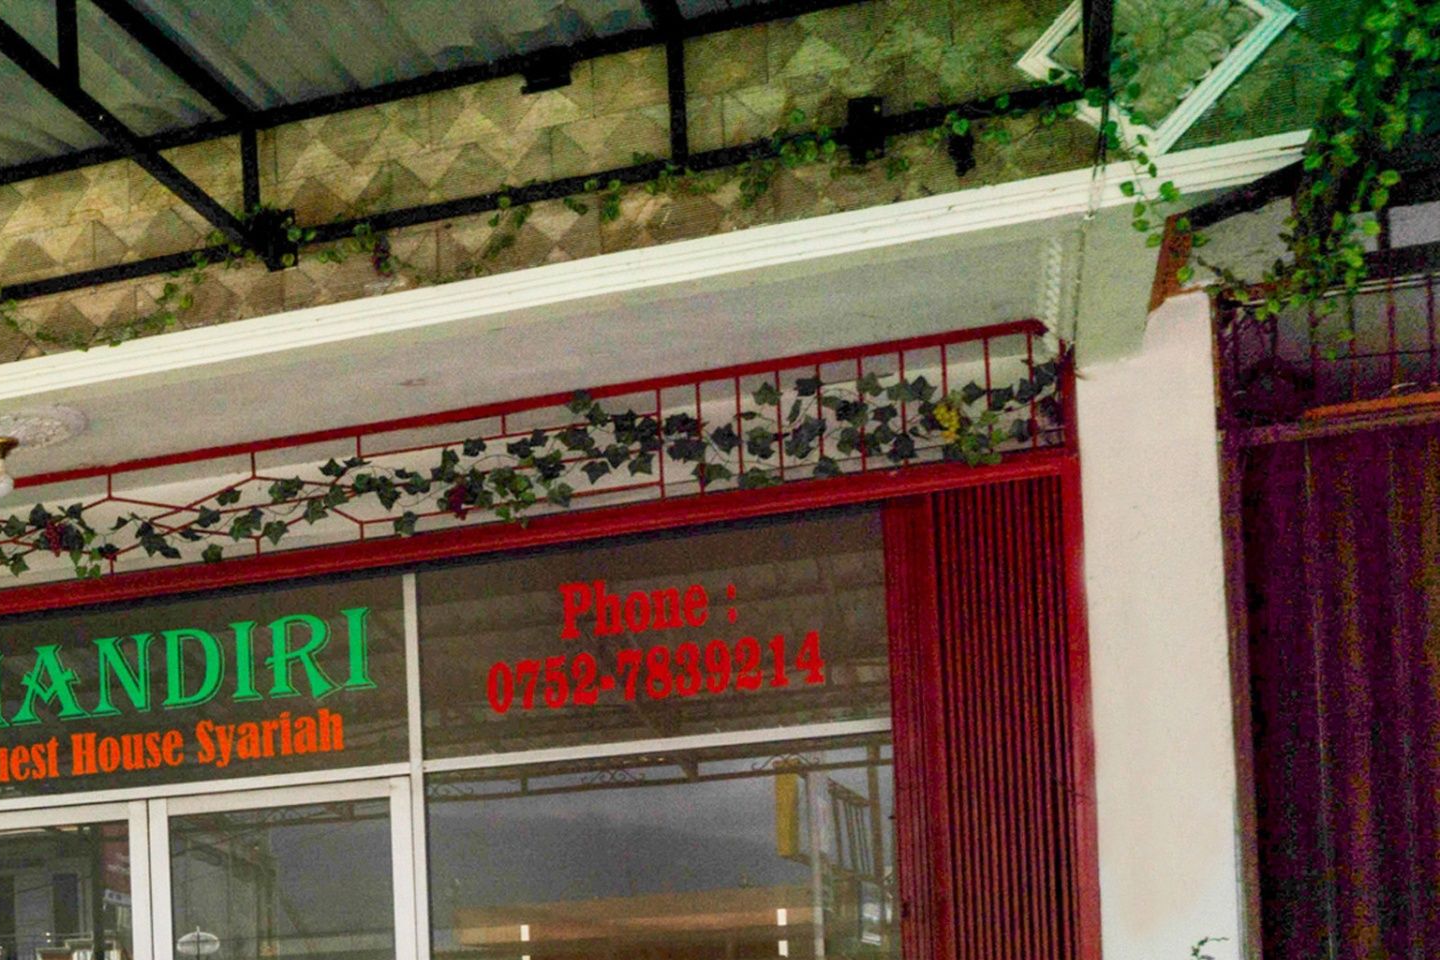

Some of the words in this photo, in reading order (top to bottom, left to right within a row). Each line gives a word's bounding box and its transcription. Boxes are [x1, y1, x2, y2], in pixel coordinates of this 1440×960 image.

[559, 580, 710, 640] Phone
[486, 630, 825, 715] 0752-7839214
[70, 728, 185, 776] House
[195, 707, 345, 768] Syariah
